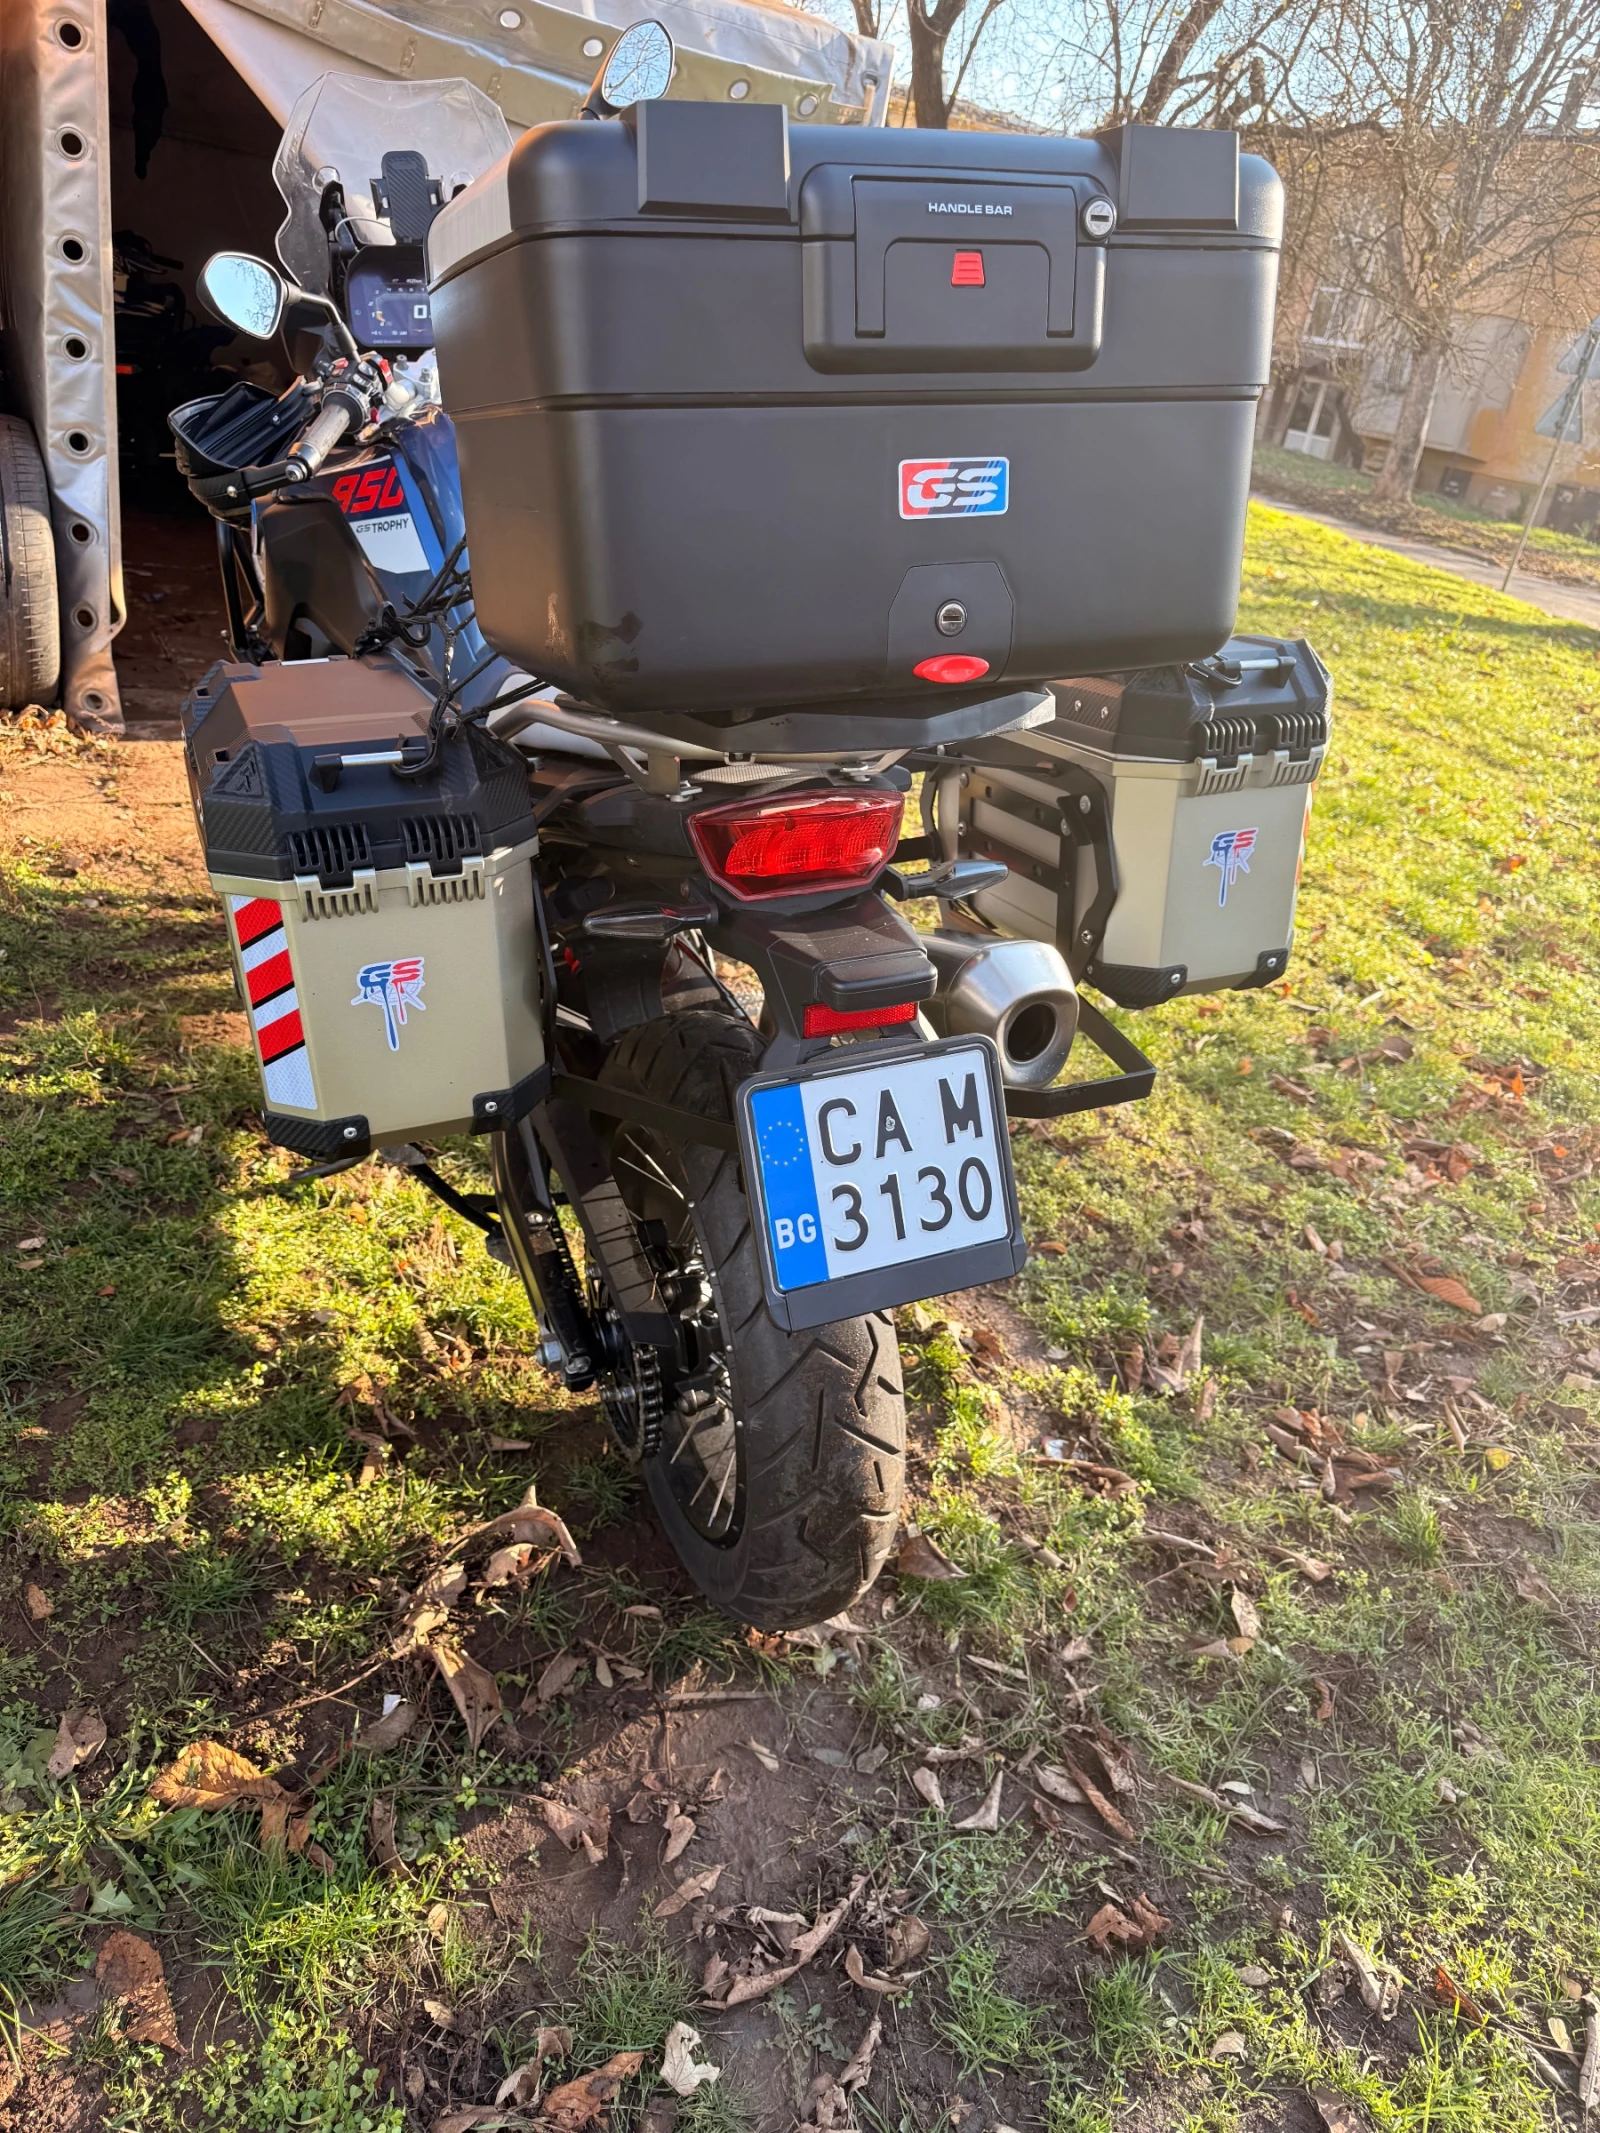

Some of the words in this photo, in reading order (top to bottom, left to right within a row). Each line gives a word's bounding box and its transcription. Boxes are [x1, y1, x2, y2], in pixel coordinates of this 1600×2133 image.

[928, 202, 983, 215] HANDLE
[985, 204, 1013, 216] BAR
[907, 467, 1003, 509] GS
[372, 517, 409, 534] TROPHY
[818, 1088, 913, 1166] CA
[937, 1072, 984, 1145] M
[831, 1156, 993, 1252] 3130
[774, 1212, 817, 1250] BG
